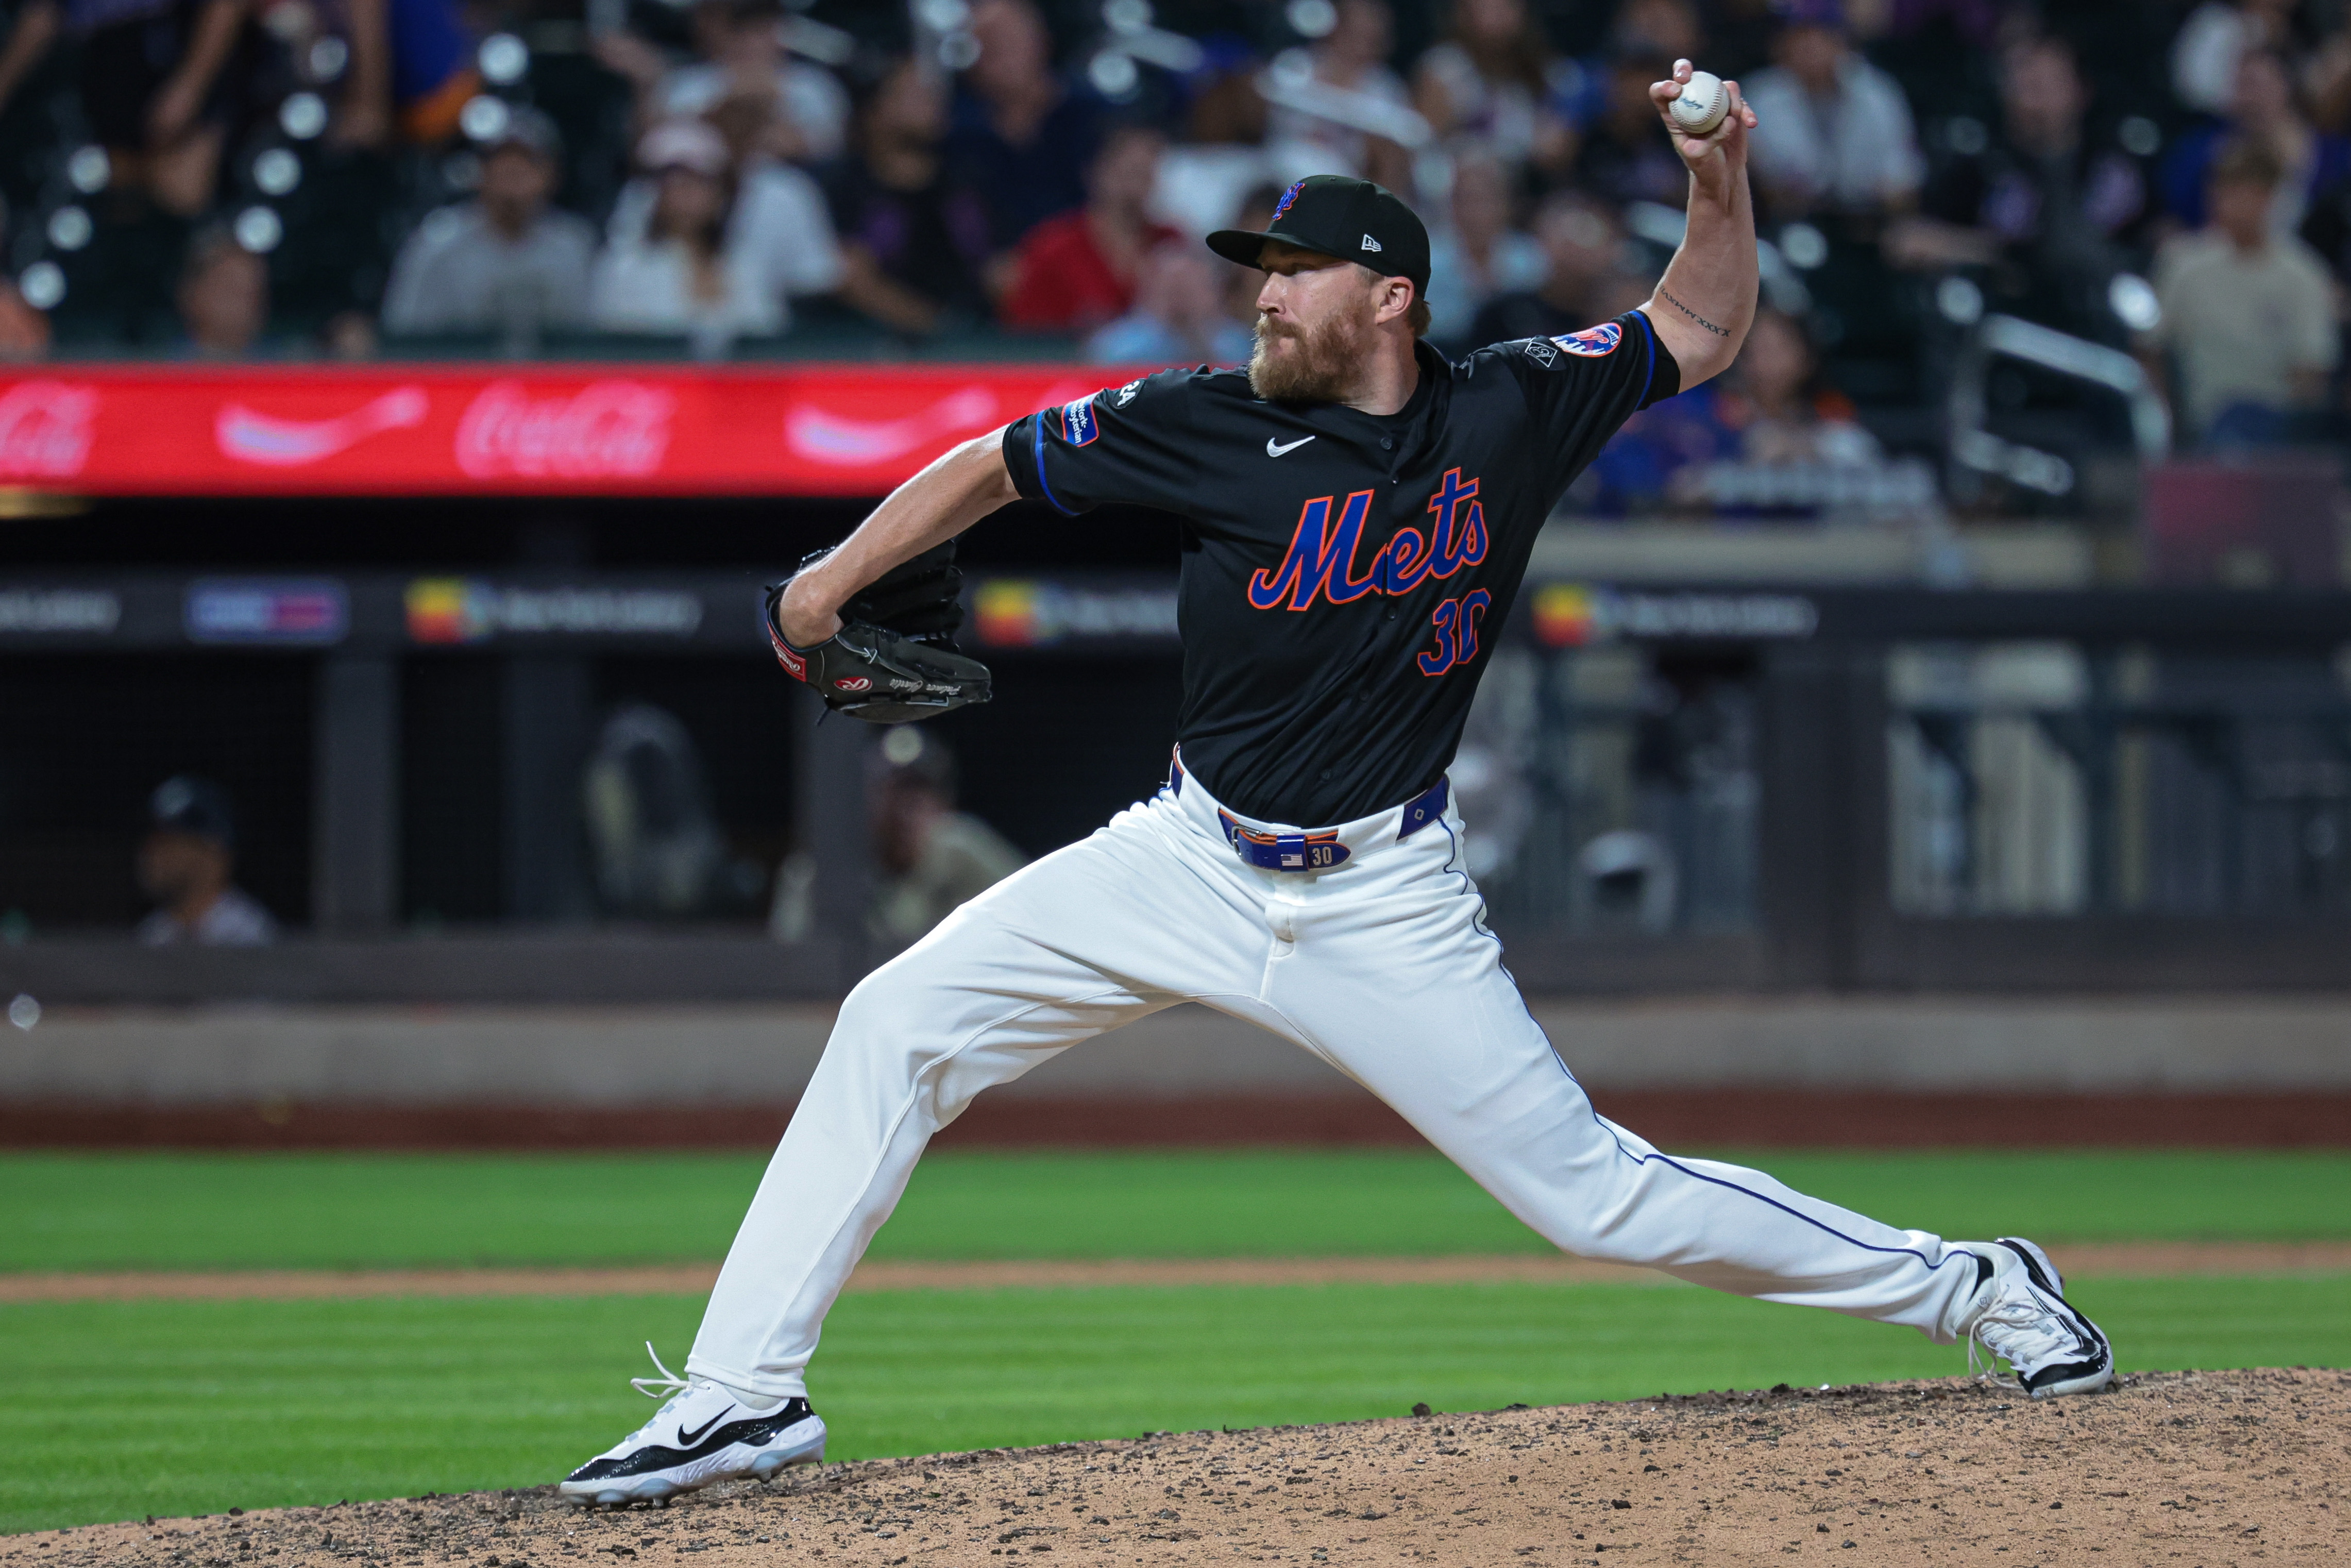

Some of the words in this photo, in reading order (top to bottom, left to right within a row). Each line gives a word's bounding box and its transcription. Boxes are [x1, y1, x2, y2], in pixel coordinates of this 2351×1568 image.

[1117, 380, 1140, 407] 24
[1247, 466, 1489, 612] Mets
[1417, 587, 1492, 677] 30
[1312, 846, 1333, 866] 30
